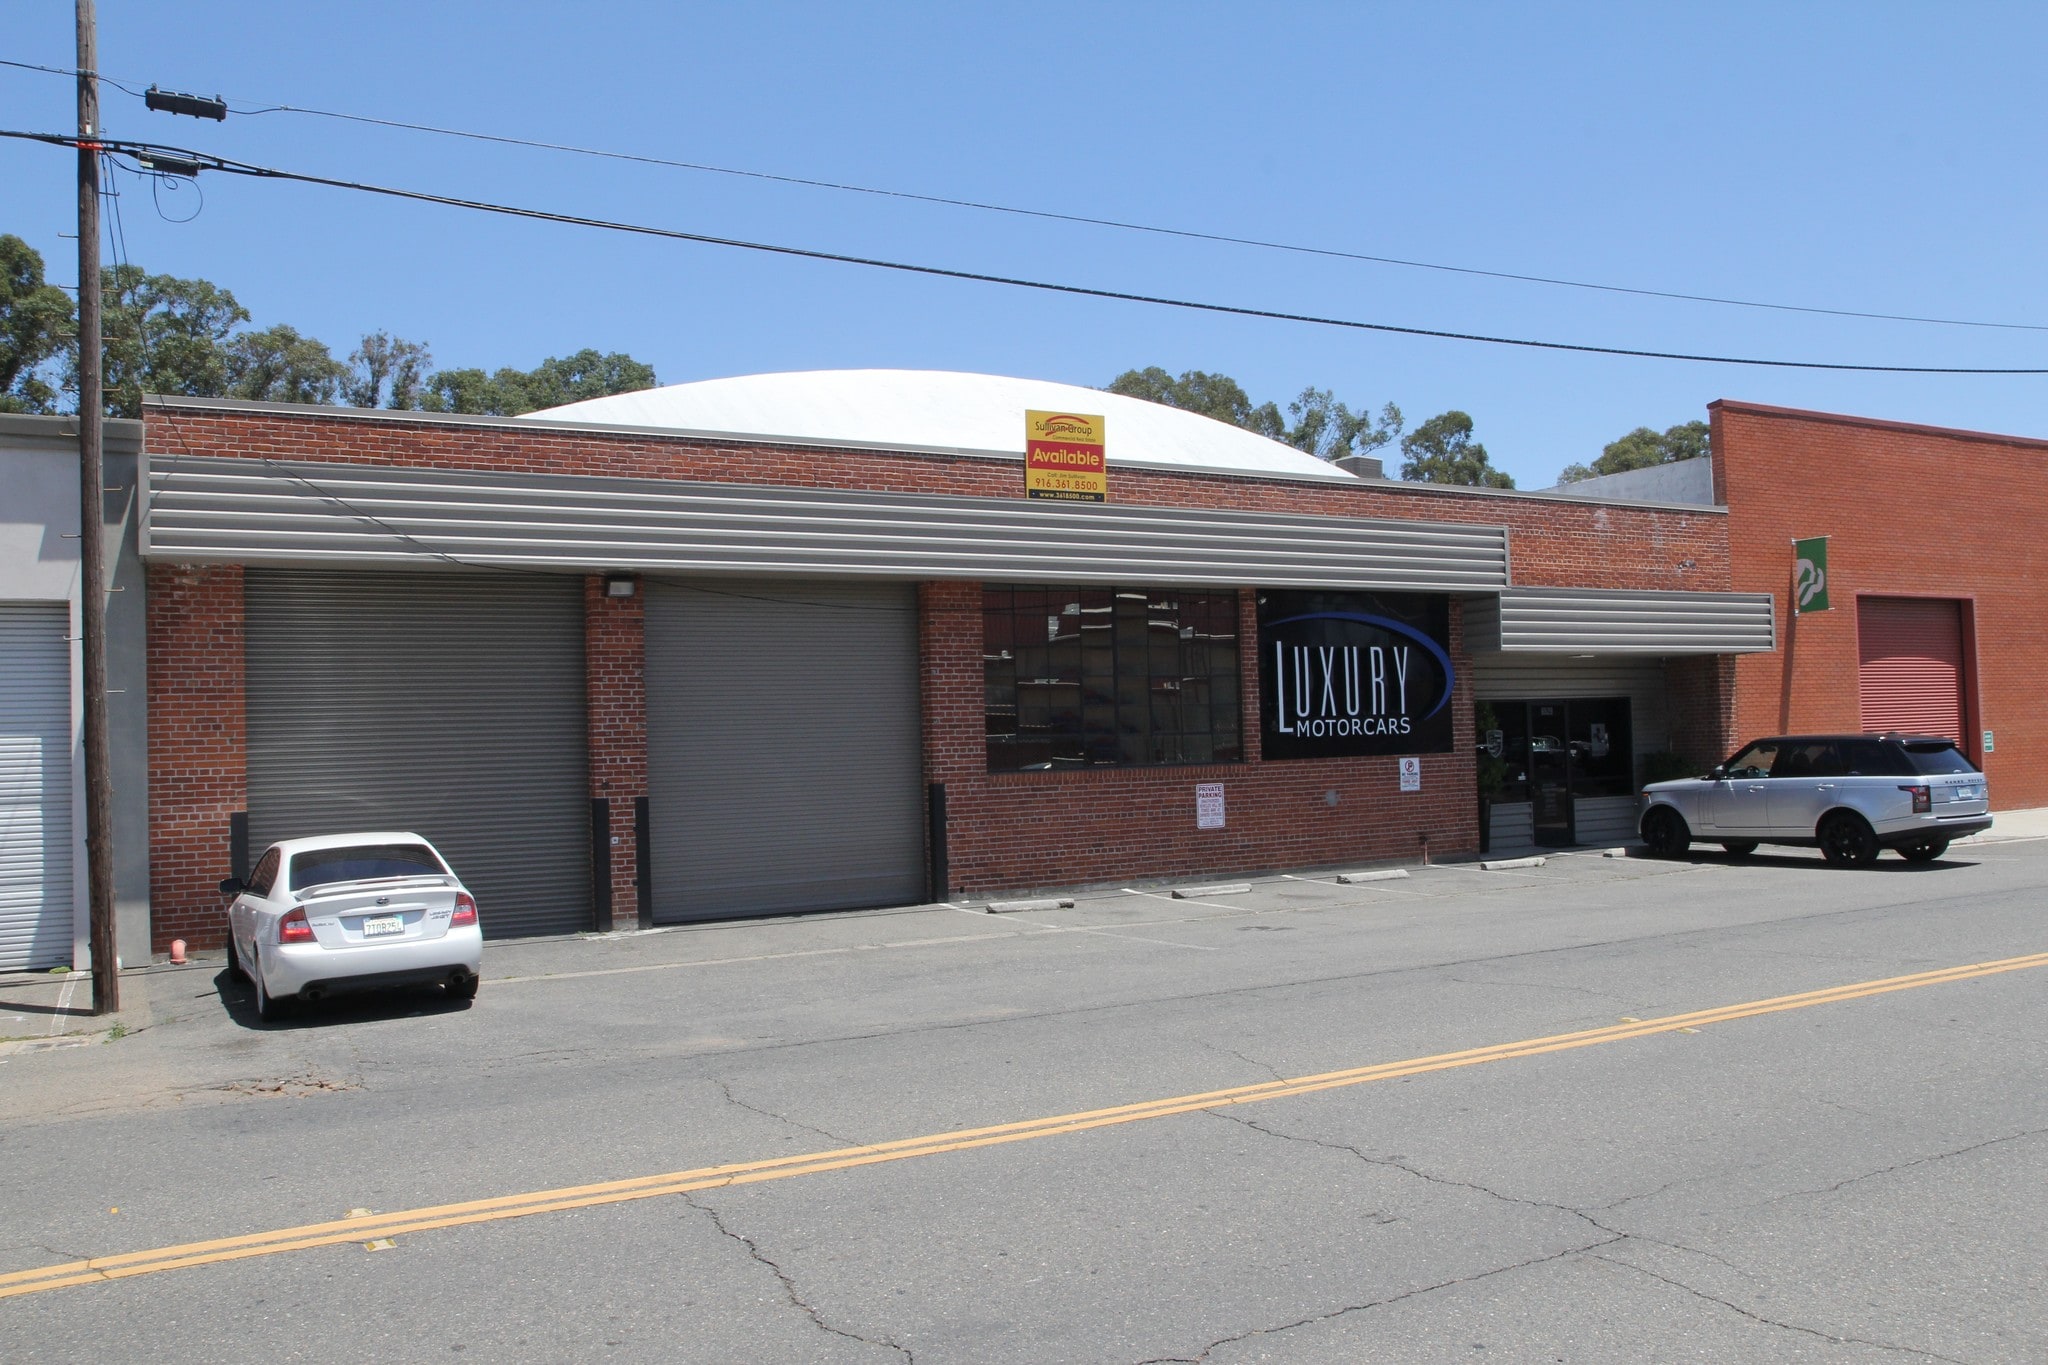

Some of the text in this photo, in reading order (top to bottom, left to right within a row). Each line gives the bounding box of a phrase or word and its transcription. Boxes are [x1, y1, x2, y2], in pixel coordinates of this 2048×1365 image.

[1035, 421, 1092, 436] Sullivan Group
[1033, 447, 1099, 466] Available
[1035, 477, 1098, 491] 916.361.8500
[1039, 491, 1095, 500] www.3618500.com
[1276, 640, 1408, 733] LUXURY
[1297, 717, 1411, 738] MOTORCARS
